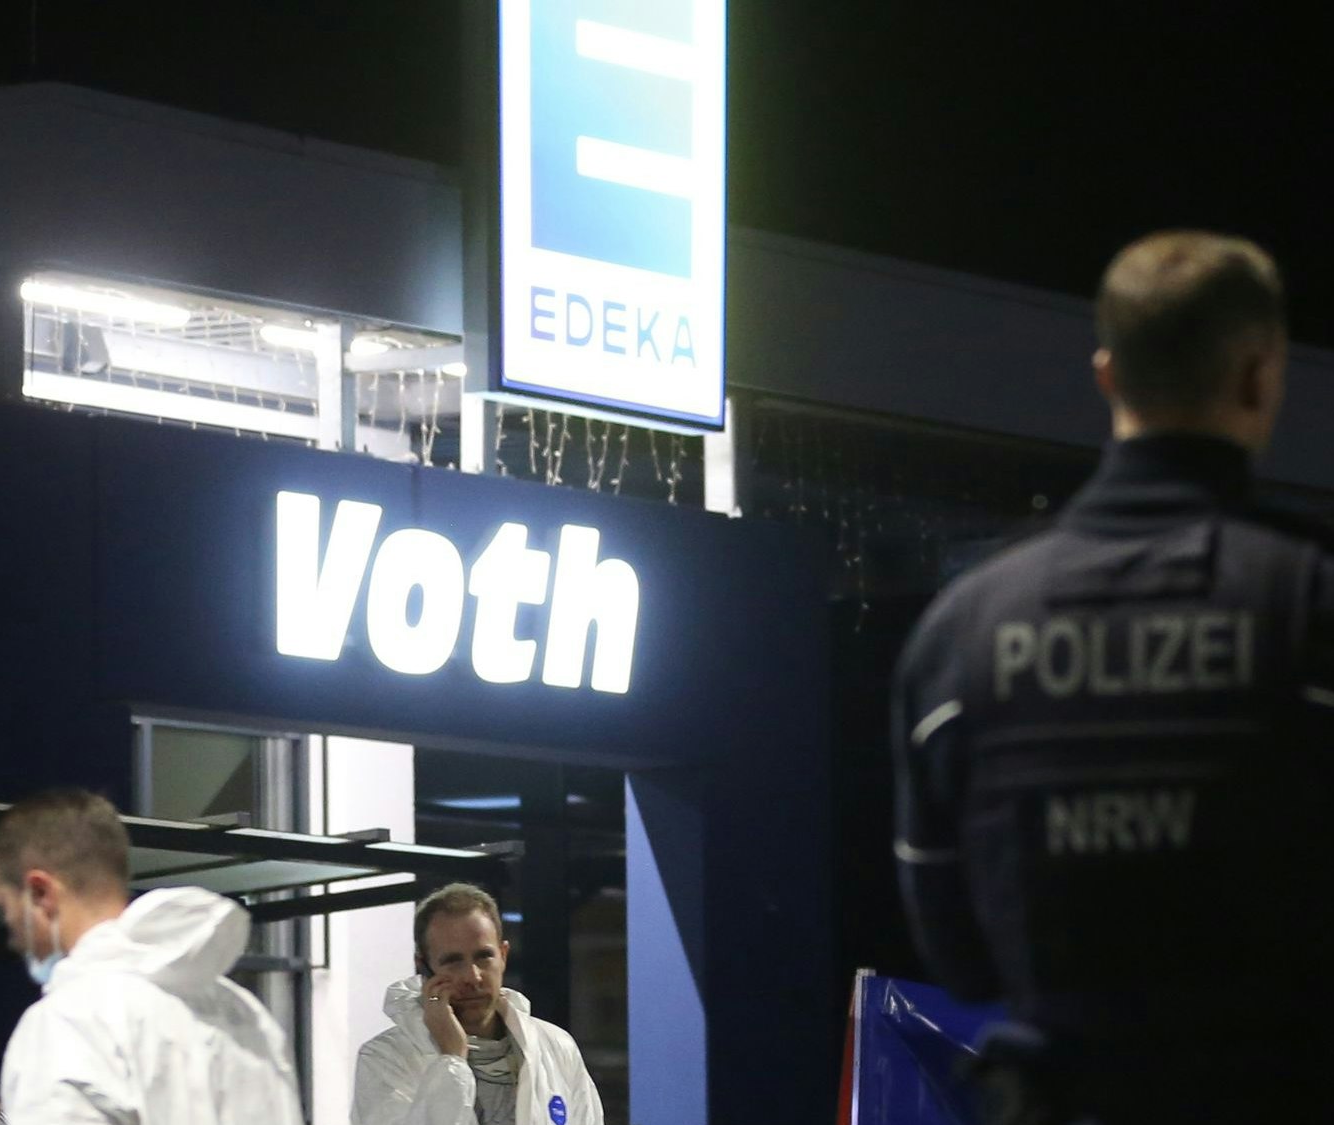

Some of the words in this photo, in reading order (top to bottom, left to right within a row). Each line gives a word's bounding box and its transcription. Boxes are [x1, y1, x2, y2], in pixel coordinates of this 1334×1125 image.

[530, 285, 697, 368] EDEKA
[275, 489, 641, 695] Voth
[992, 609, 1256, 702] POLIZEI
[1044, 789, 1197, 857] NRW
